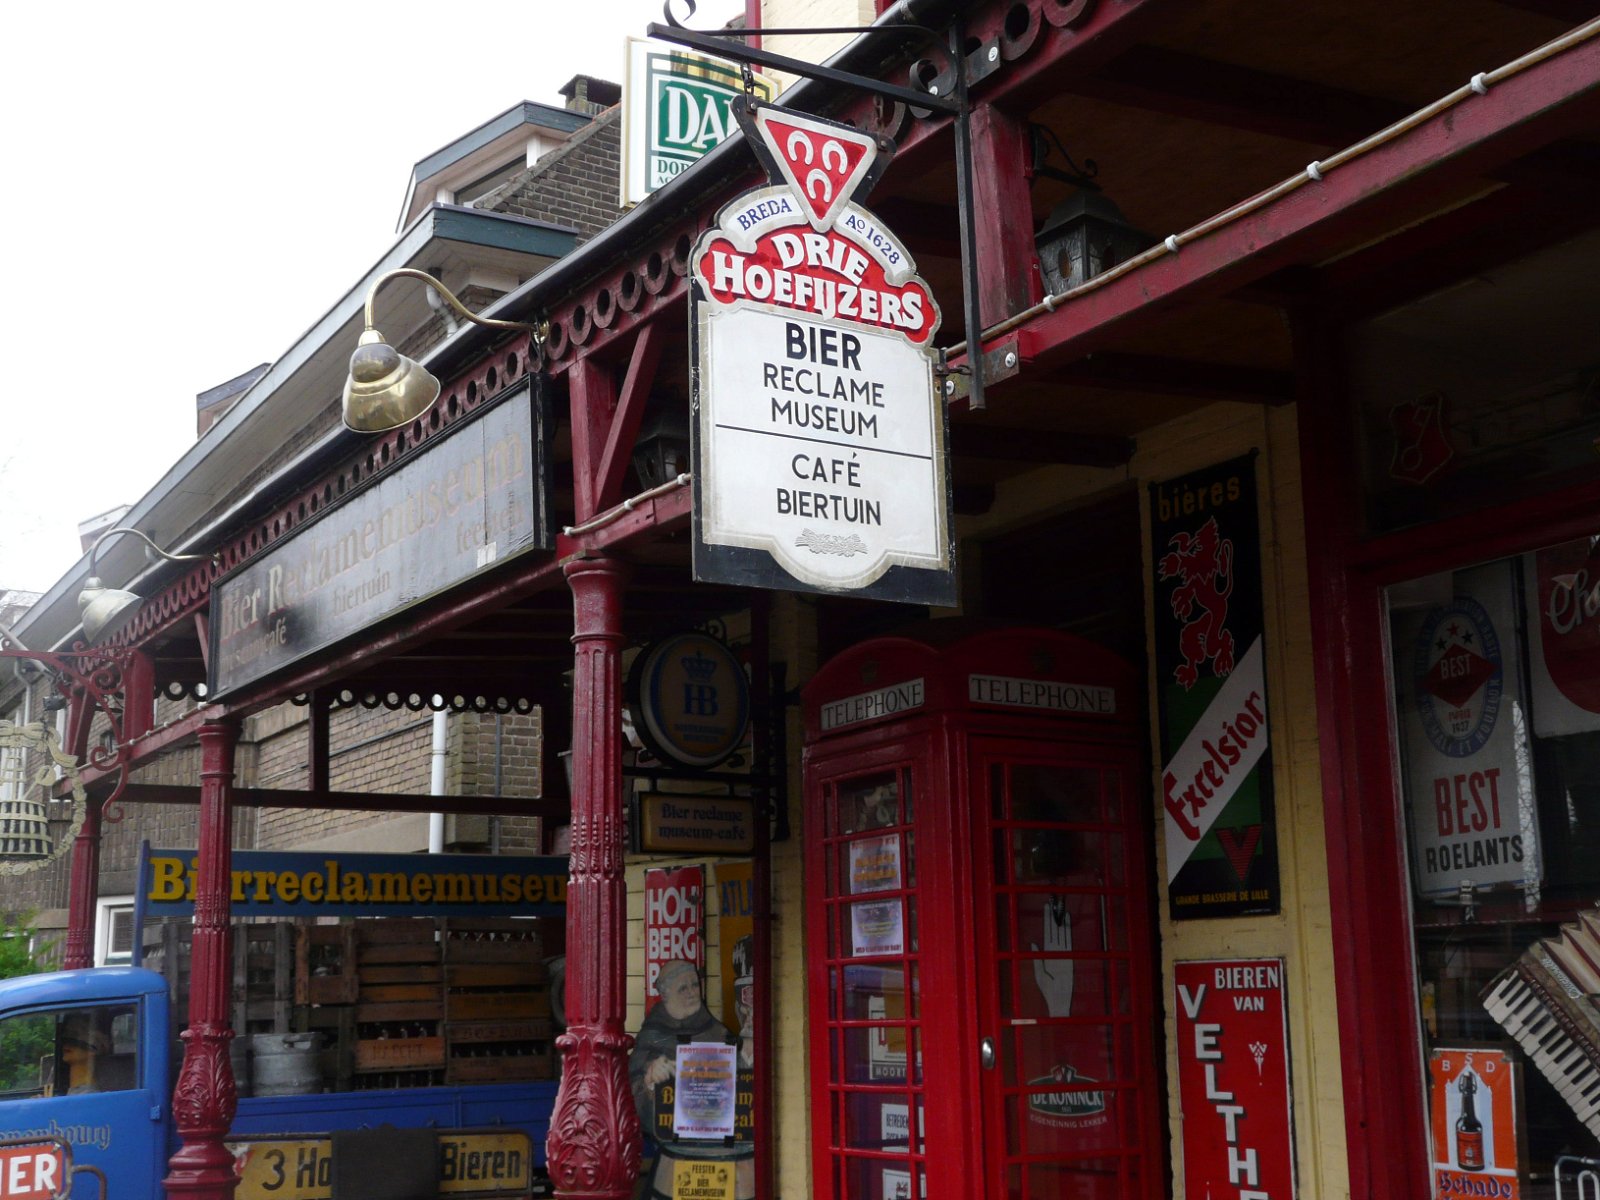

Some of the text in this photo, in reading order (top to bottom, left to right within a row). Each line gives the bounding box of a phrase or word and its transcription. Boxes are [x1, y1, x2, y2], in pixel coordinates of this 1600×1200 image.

[737, 198, 792, 231] BREDA
[866, 227, 900, 264] 1628
[771, 232, 870, 286] DRIE
[786, 322, 862, 371] BIER
[763, 362, 886, 408] RECLAME
[771, 397, 879, 438] MUSEUM
[791, 452, 862, 488] CAFÉ
[776, 488, 882, 526] BIERTUIN
[1157, 475, 1242, 523] bières
[219, 586, 261, 643] Bier
[1440, 654, 1472, 681] BEST
[683, 684, 719, 716] HB
[823, 682, 923, 729] TELEPHONE
[970, 677, 1112, 713] TELEPHONE
[1162, 691, 1264, 841] Excelsior
[661, 803, 690, 820] Bier
[1433, 768, 1501, 837] BEST
[1425, 835, 1524, 874] ROELANTS
[148, 856, 568, 905] Birreclamemuseu
[649, 886, 697, 925] HOH
[648, 926, 697, 960] BERG
[1214, 966, 1279, 989] BIEREN
[1233, 997, 1264, 1011] VAN
[1177, 984, 1268, 1200] VELTH
[261, 1149, 286, 1190] 3
[439, 1141, 520, 1183] Bieren
